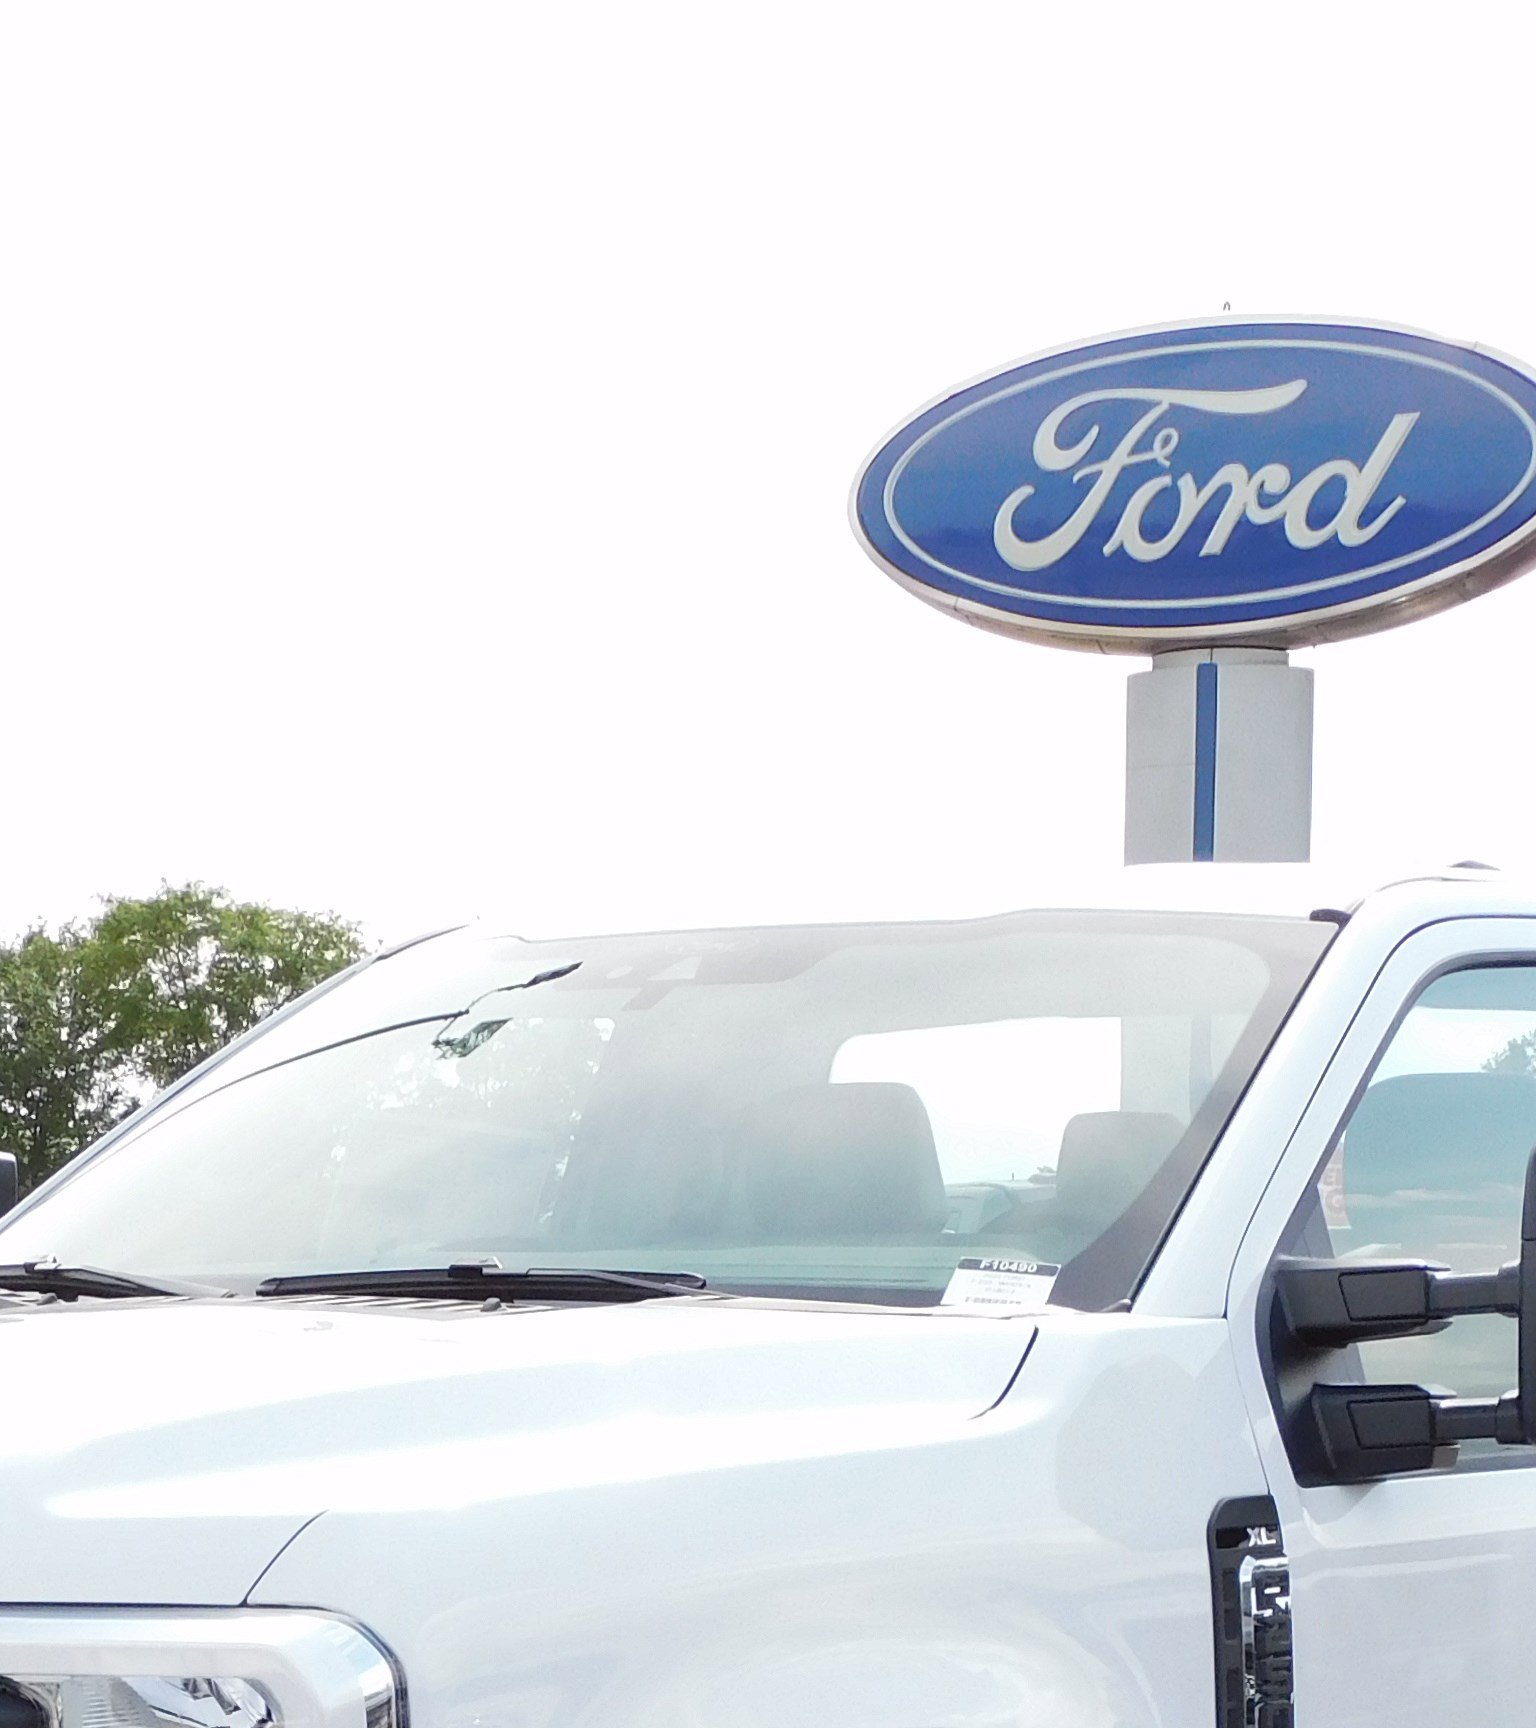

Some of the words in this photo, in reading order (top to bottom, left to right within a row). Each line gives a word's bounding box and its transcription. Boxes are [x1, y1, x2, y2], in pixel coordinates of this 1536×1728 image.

[992, 378, 1421, 572] Ford
[979, 1259, 1038, 1273] F10490
[1246, 1526, 1277, 1547] XL
